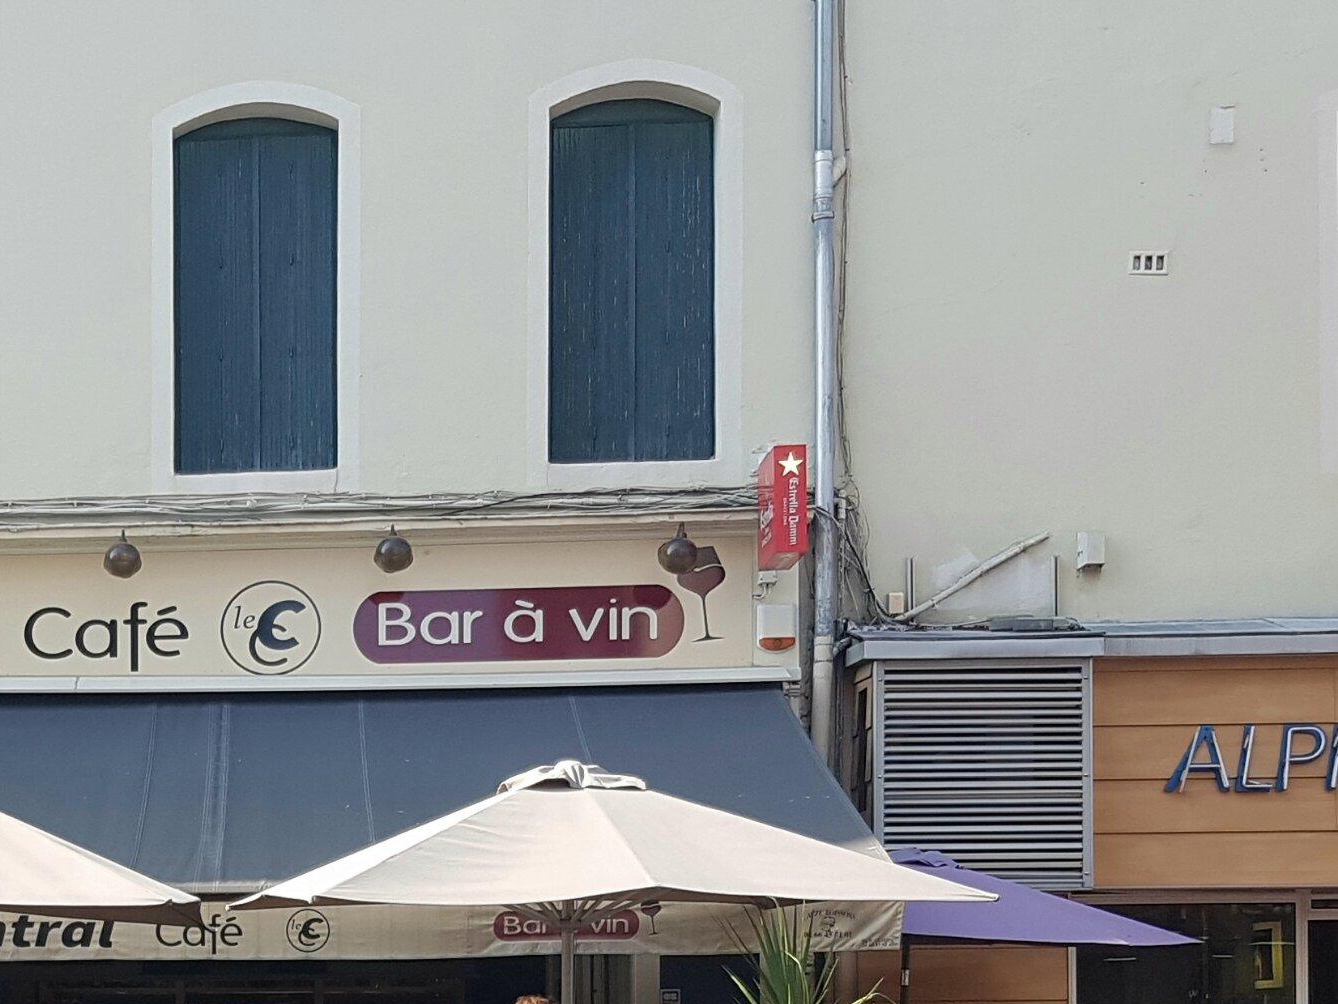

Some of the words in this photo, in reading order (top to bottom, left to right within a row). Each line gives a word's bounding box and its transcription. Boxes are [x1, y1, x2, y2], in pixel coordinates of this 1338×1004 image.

[789, 477, 799, 513] Estrella
[789, 516, 799, 545] Damm
[23, 600, 190, 673] Café
[376, 601, 483, 648] Bar
[503, 600, 546, 645] à
[568, 597, 659, 643] vin
[156, 914, 243, 954] Café
[590, 914, 630, 934] vin
